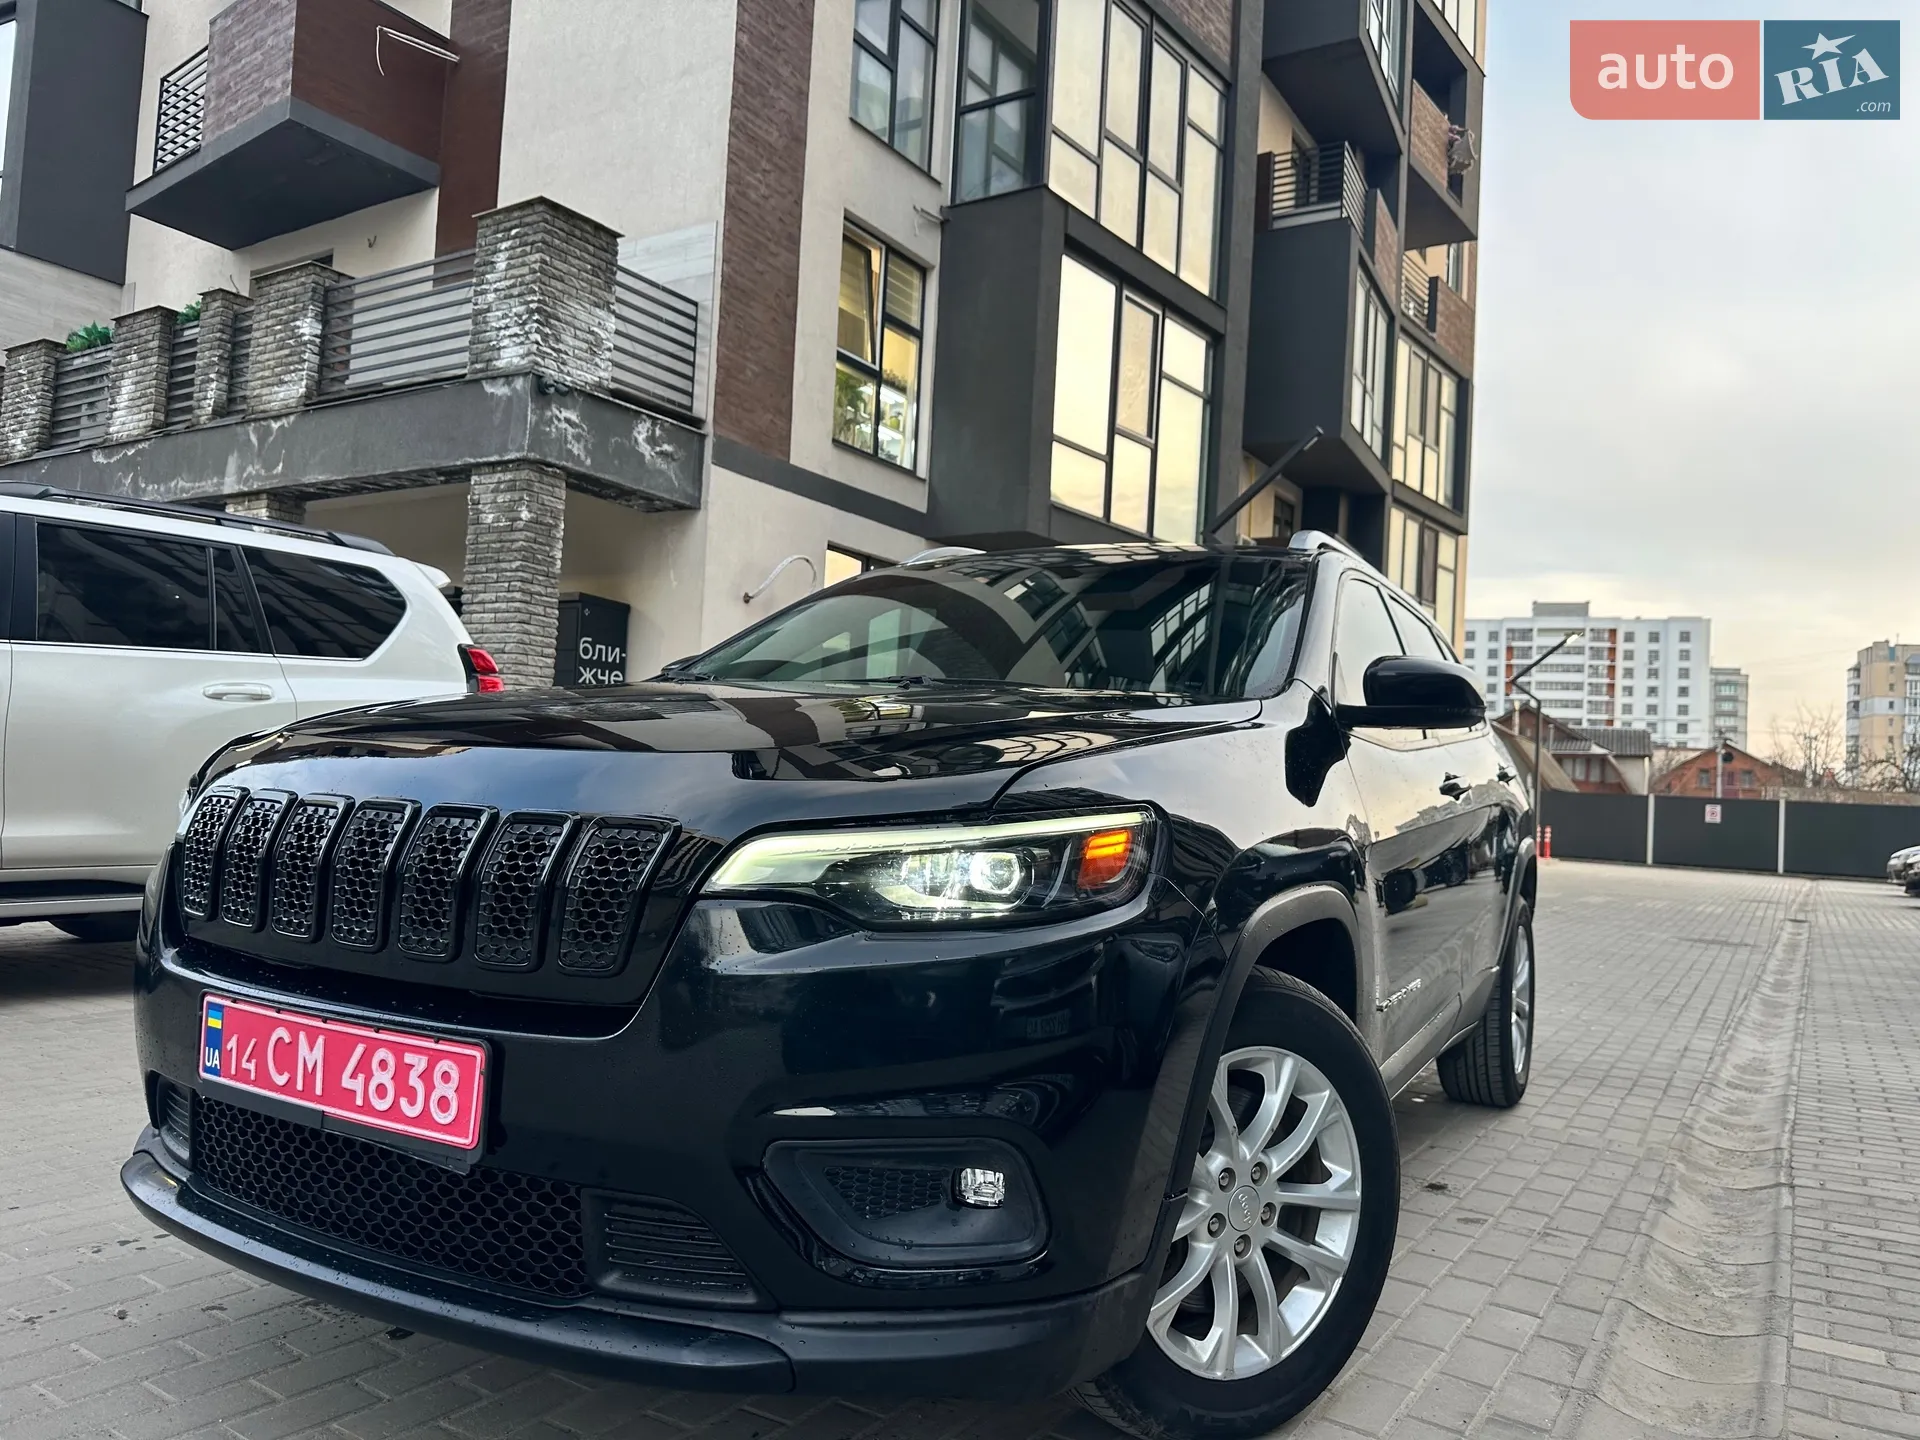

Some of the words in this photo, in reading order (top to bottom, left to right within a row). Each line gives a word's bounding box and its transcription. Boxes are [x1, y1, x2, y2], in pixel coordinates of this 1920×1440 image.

[579, 636, 627, 664] бли-
[578, 665, 624, 685] жче
[205, 1048, 220, 1070] UA
[226, 1033, 257, 1081] 14
[267, 1026, 326, 1096] CM
[341, 1043, 461, 1125] 4838
